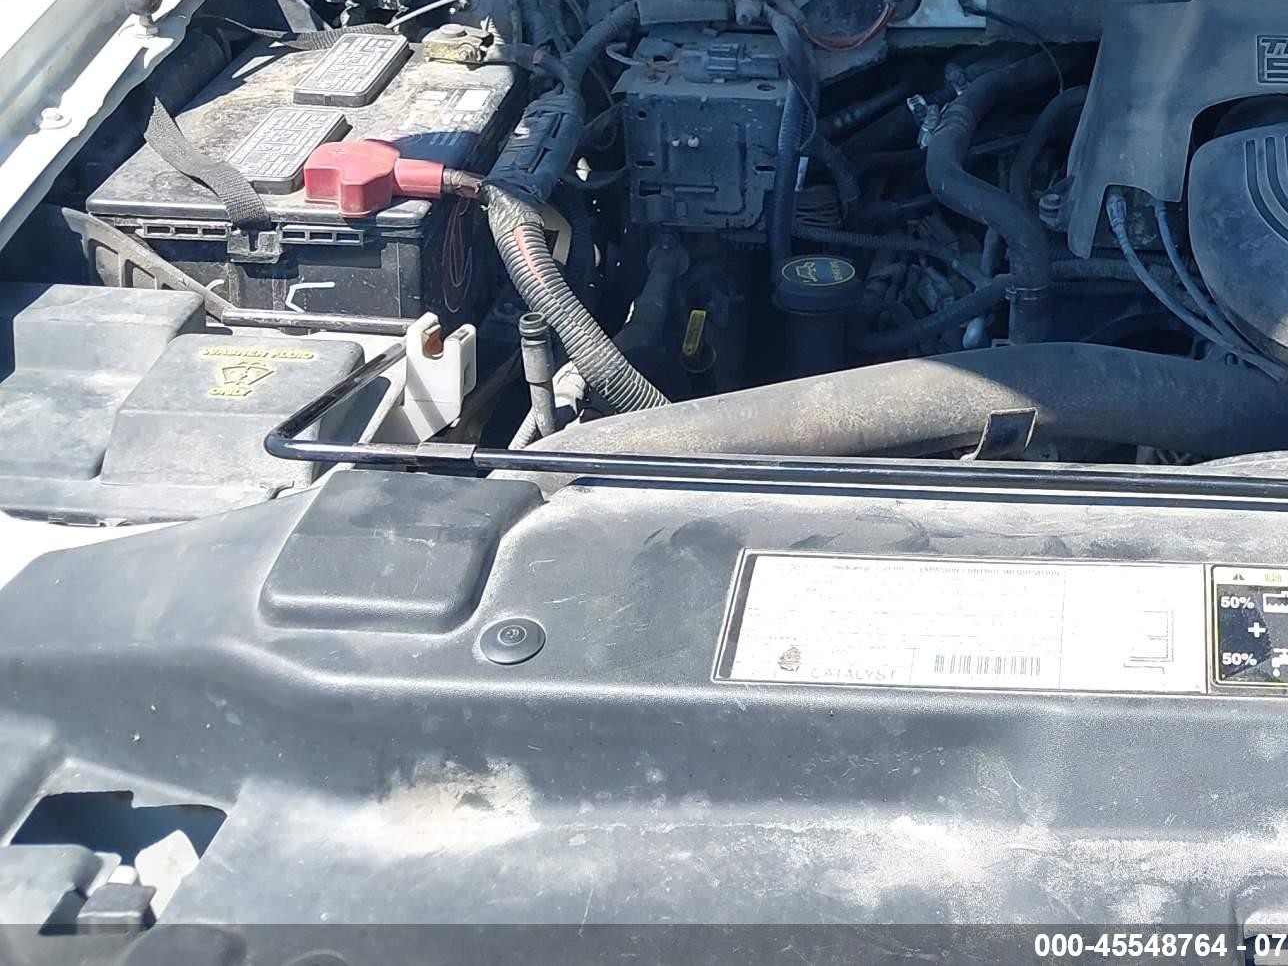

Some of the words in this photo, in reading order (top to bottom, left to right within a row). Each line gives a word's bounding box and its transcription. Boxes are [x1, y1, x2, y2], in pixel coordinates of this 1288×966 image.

[210, 386, 253, 397] ONLY
[1220, 595, 1255, 610] 50%
[1221, 652, 1258, 666] 50%
[810, 667, 898, 681] CATALYST
